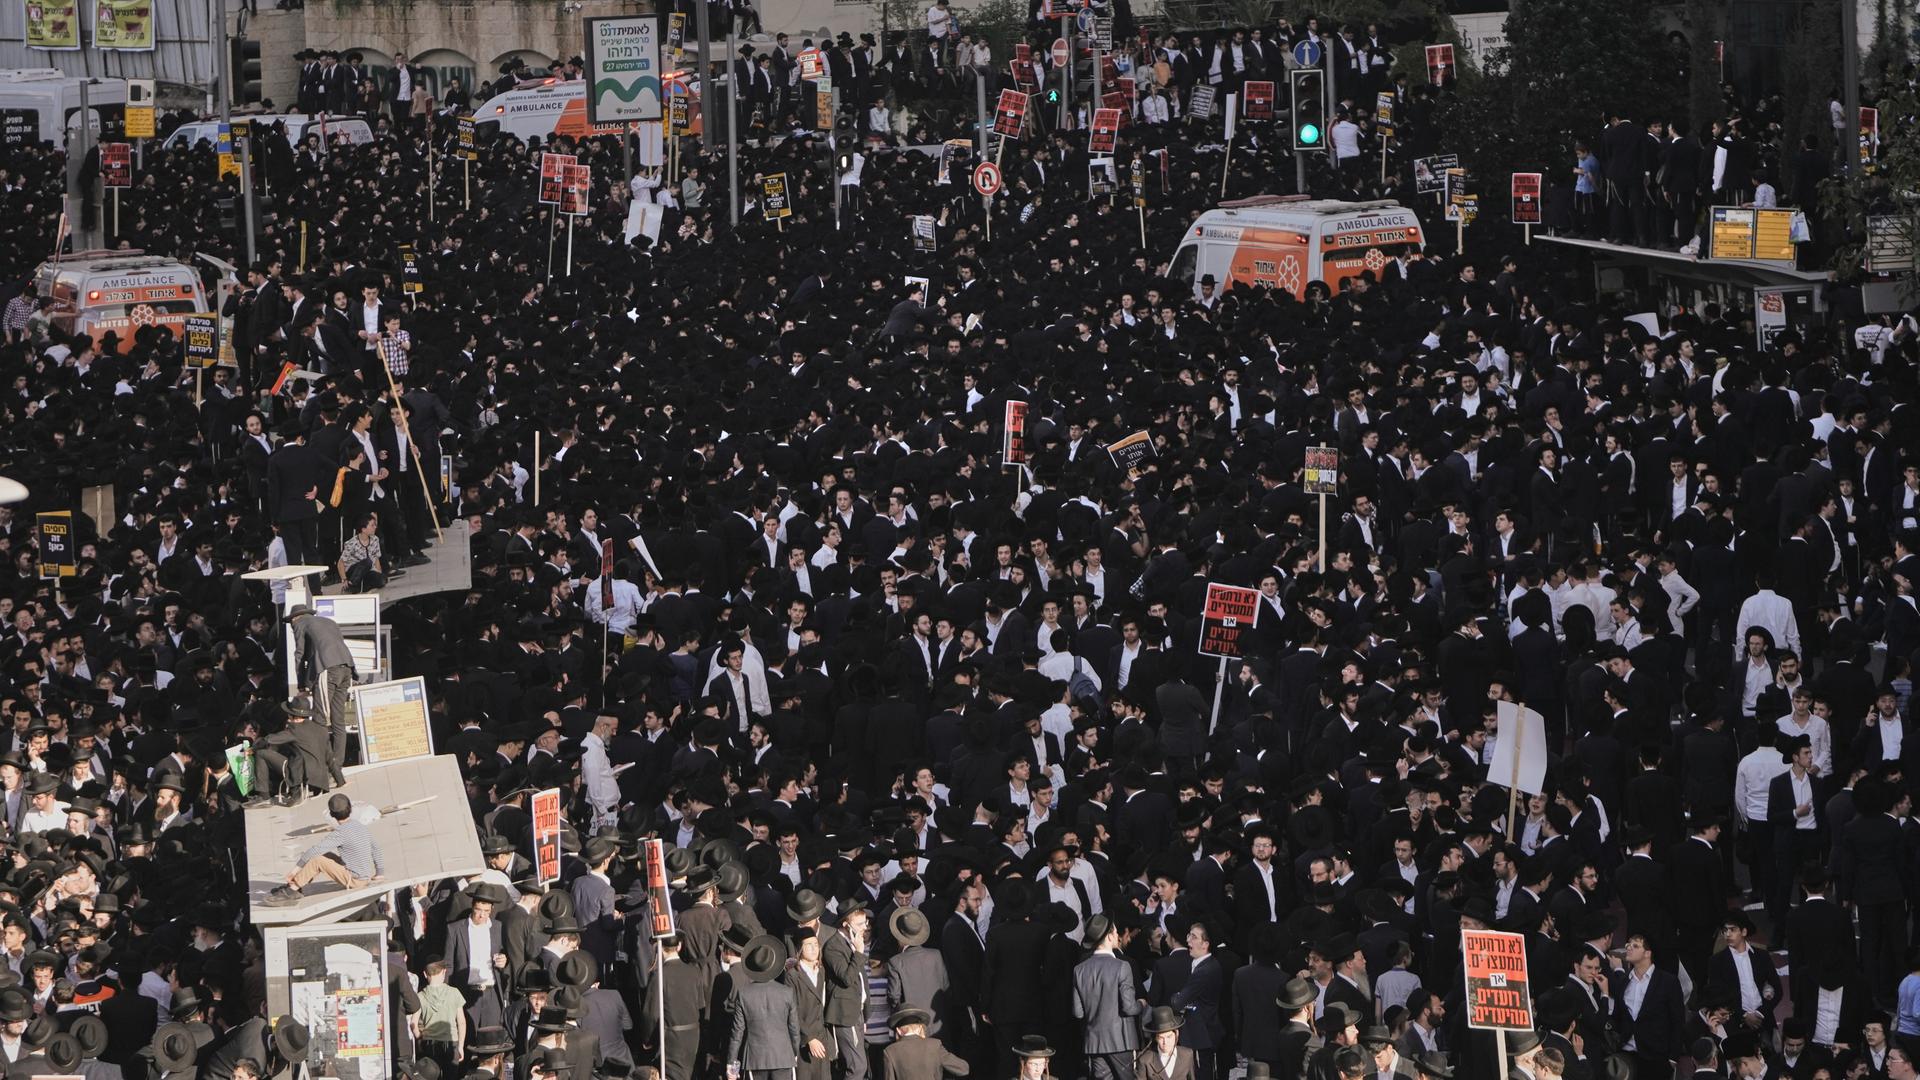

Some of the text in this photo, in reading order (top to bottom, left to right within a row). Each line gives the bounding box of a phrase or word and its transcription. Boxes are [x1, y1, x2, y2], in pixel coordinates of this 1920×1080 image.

[601, 36, 650, 46] מרפאת שיניים
[607, 46, 644, 58] ירמיהו
[511, 102, 563, 112] AMBULANCE
[624, 107, 642, 115] לאומית
[1337, 216, 1406, 231] AMBULANCE
[1206, 229, 1239, 240] AMBULANCE
[1339, 232, 1406, 249] איחוד הצלה
[1254, 260, 1275, 274] איחוד
[1336, 260, 1363, 269] UNITED
[103, 276, 176, 288] AMBULANCE
[106, 288, 176, 303] איחוד הצלה
[94, 318, 129, 329] UNITED
[187, 325, 217, 333] הישיבות
[1118, 442, 1146, 456] מחזירים
[1127, 449, 1144, 460] אותו
[45, 525, 65, 533] רוסיה
[1244, 591, 1257, 604] לא
[1467, 936, 1522, 954] לא נרתעים
[1491, 974, 1504, 985] אך
[1477, 988, 1520, 1007] רועדים
[1472, 1006, 1529, 1025] מהיעדים.
